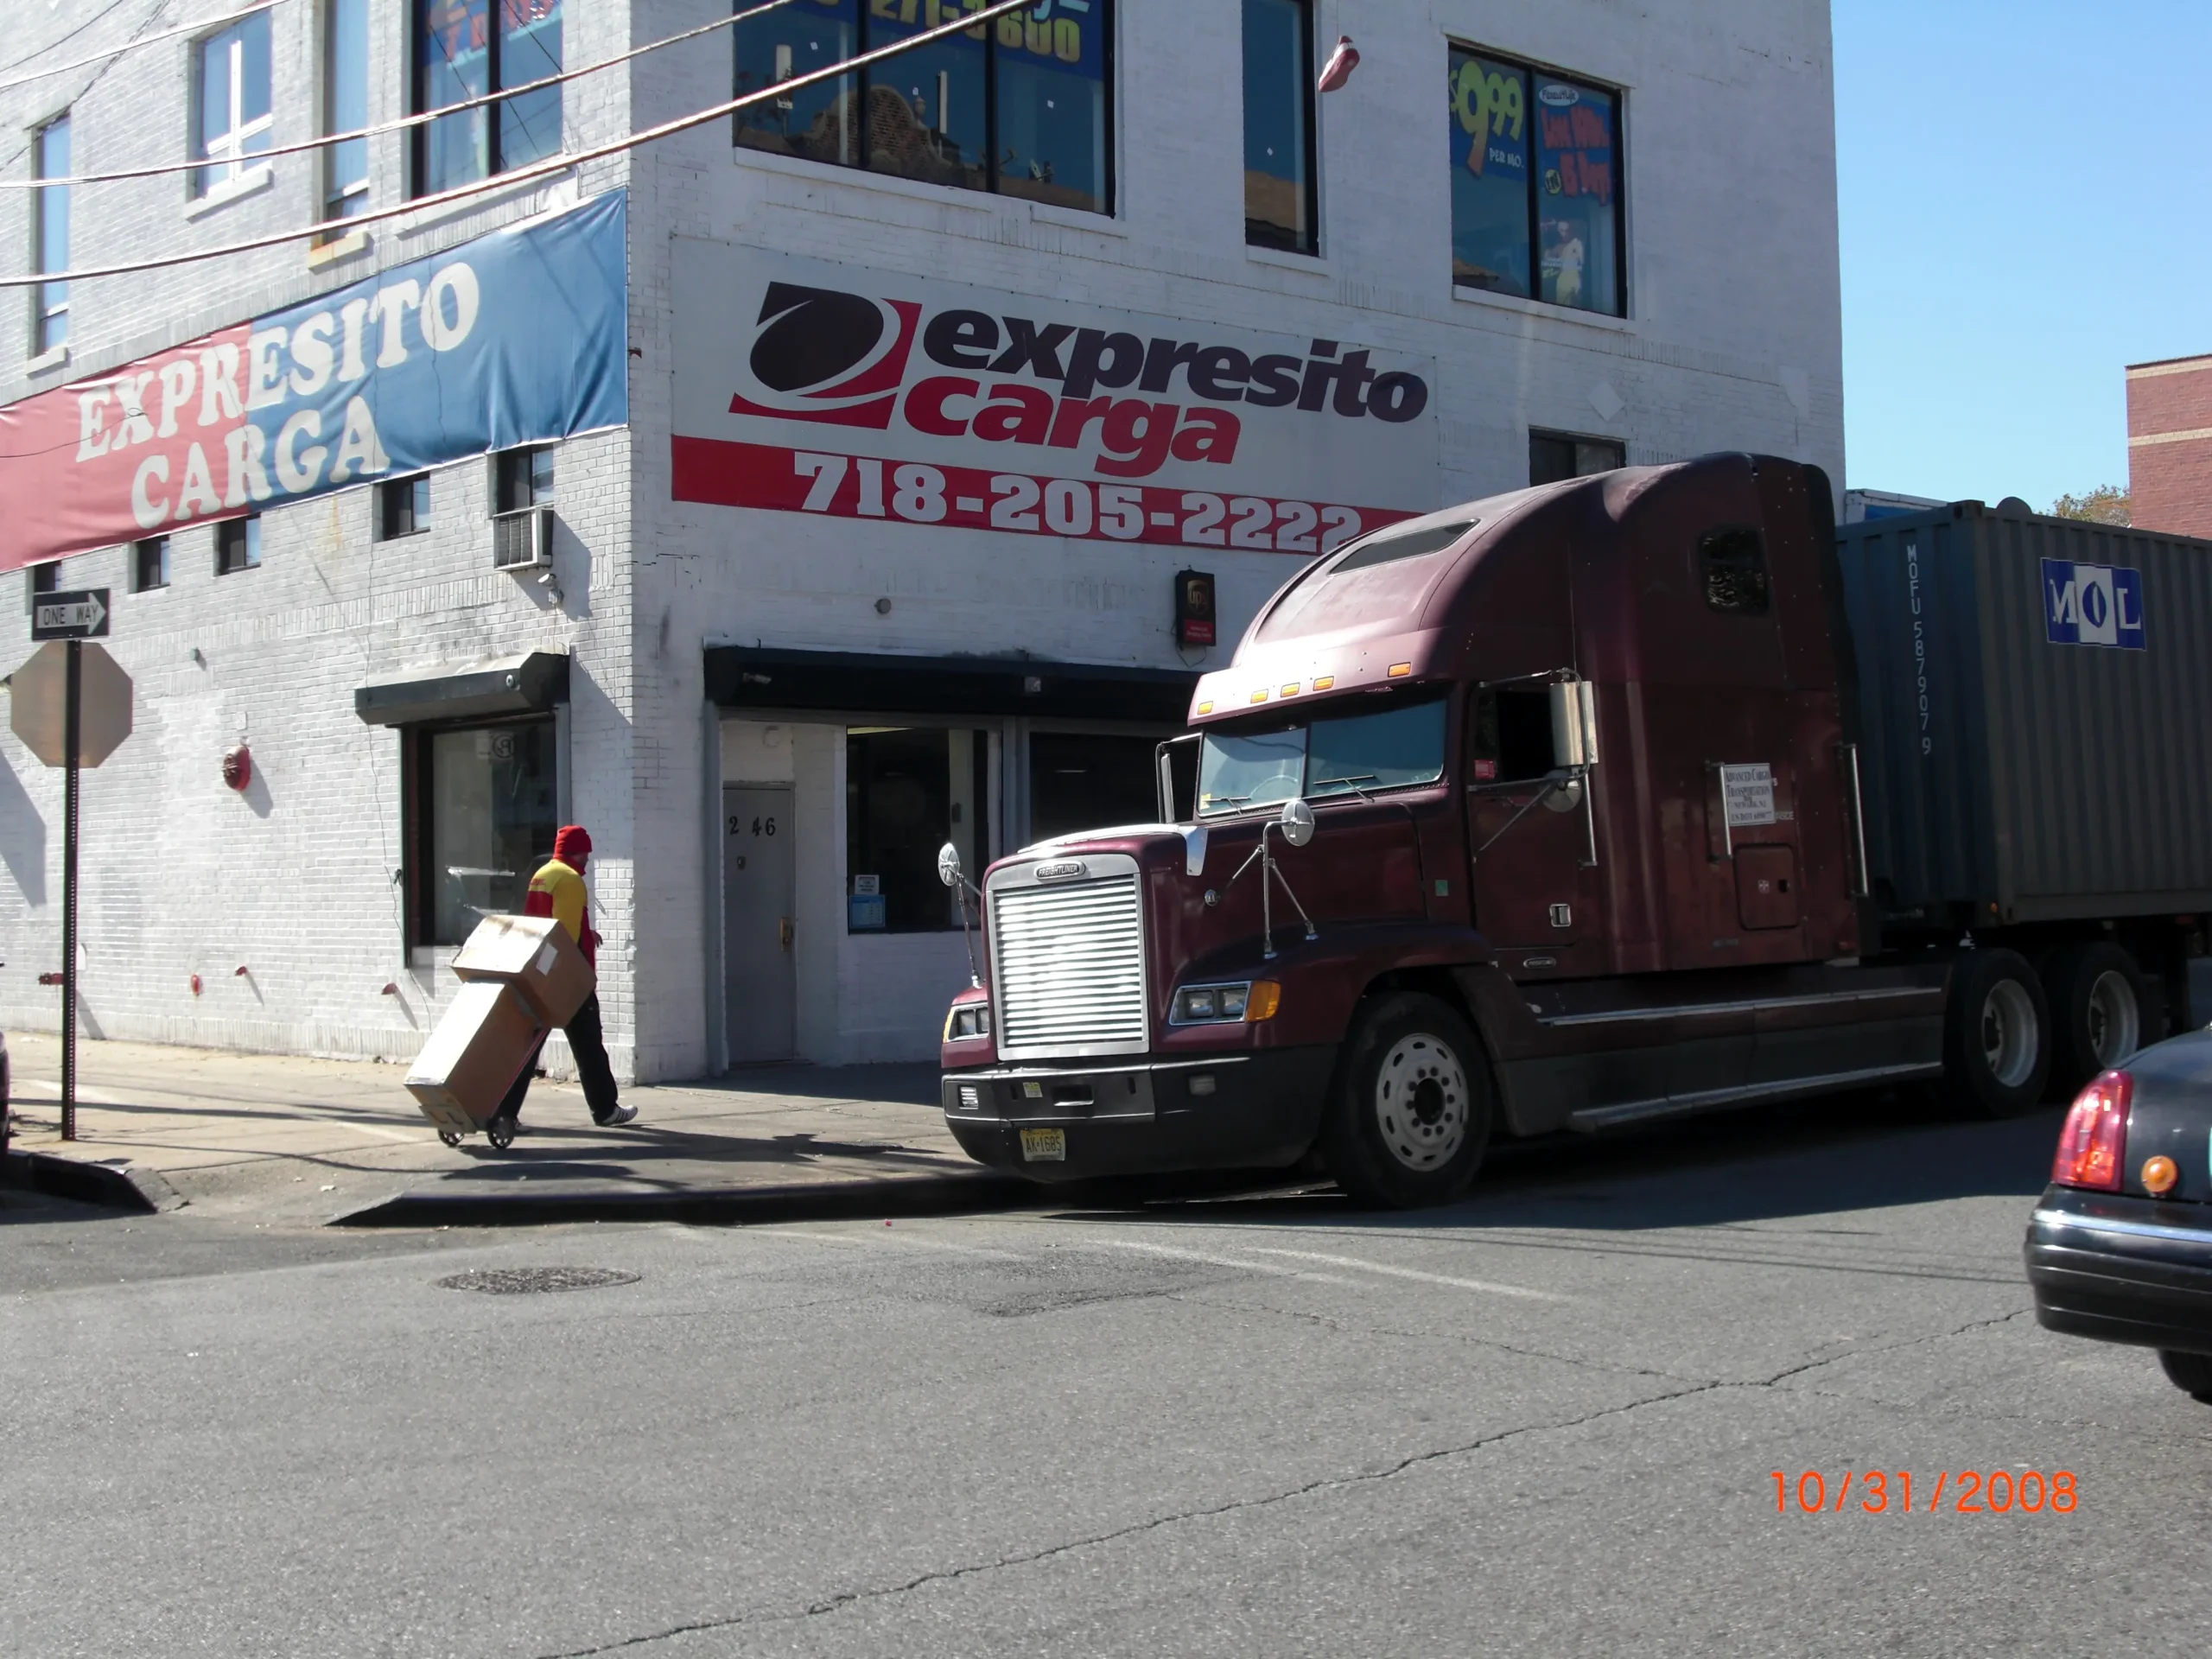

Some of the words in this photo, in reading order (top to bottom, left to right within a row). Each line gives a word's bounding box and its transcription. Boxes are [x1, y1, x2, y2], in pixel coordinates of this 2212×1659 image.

[1490, 148, 1505, 163] PER
[75, 262, 480, 463] EXPRESITO
[922, 308, 1428, 423] expresito
[131, 395, 391, 529] CARGA
[904, 375, 1241, 478] carga
[794, 451, 1362, 554] 718-205-2222
[43, 607, 66, 625] ONE
[76, 604, 99, 623] WAY
[1906, 543, 1922, 615] MOFU
[2049, 578, 2141, 630] MOL
[1913, 620, 1929, 731] 587907
[1039, 864, 1078, 877] FREIGHTLINER
